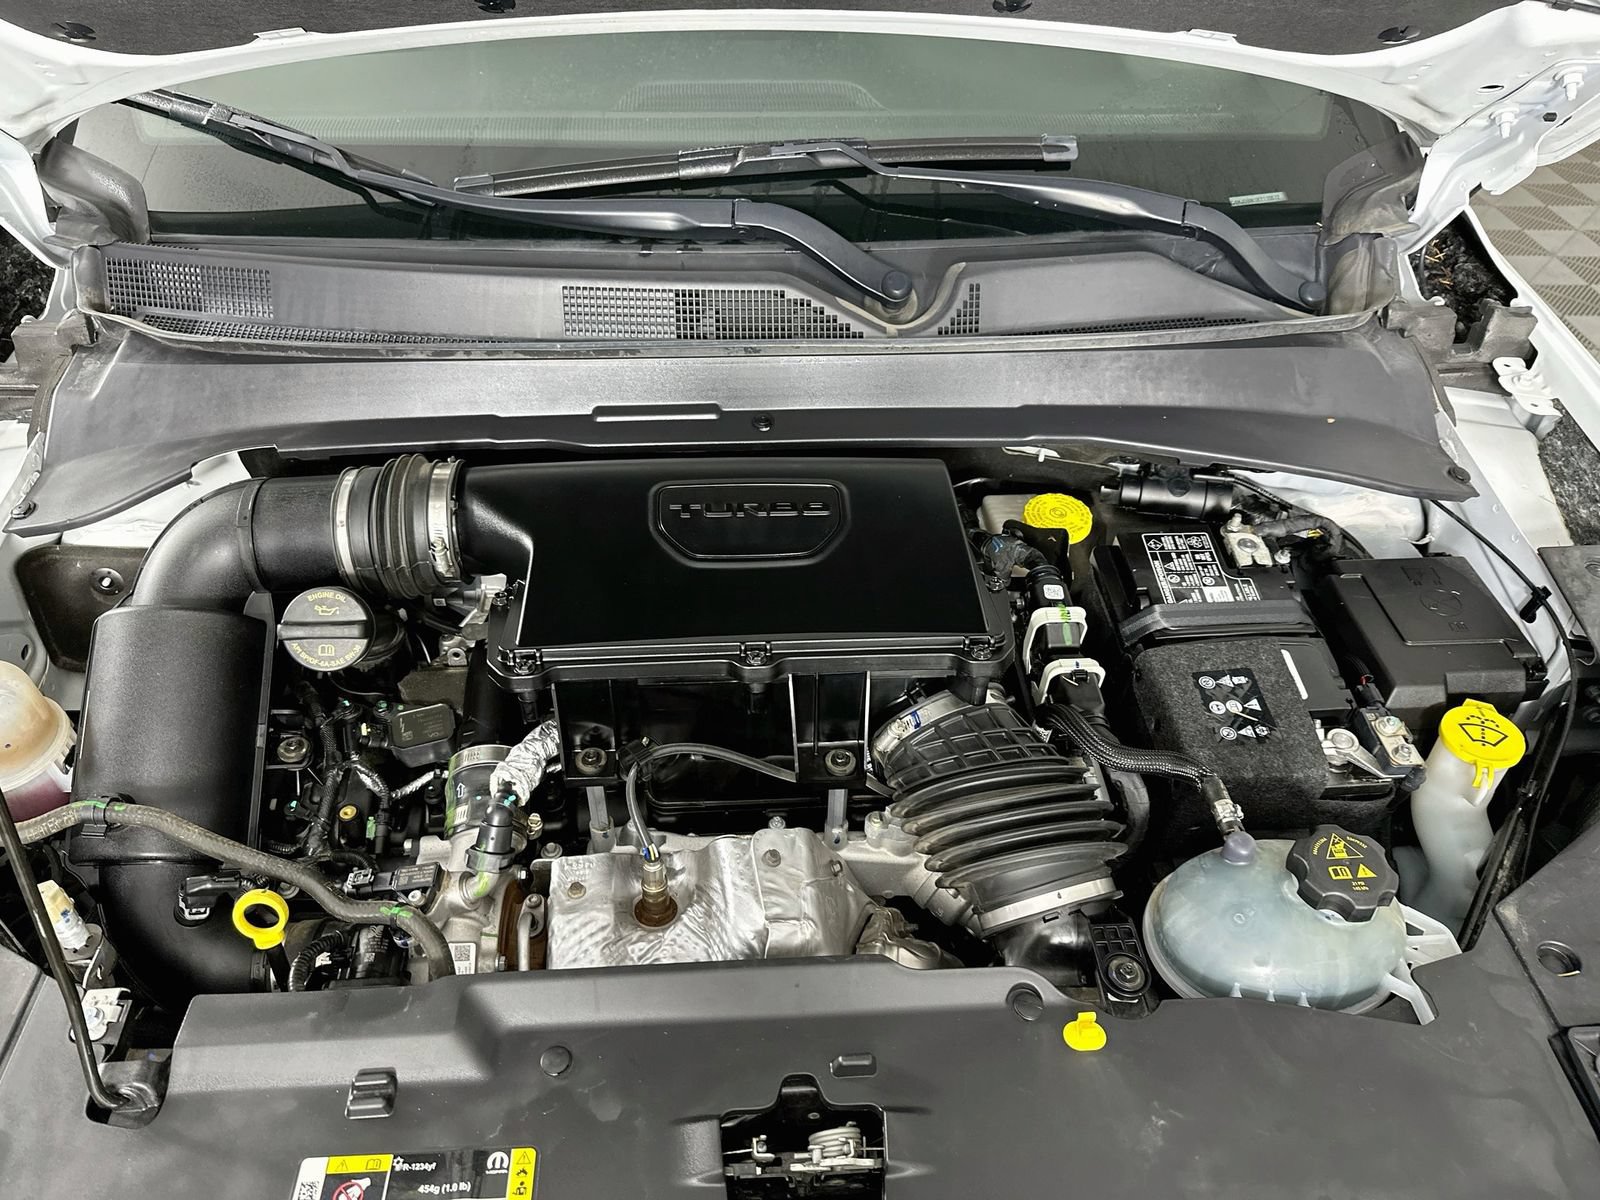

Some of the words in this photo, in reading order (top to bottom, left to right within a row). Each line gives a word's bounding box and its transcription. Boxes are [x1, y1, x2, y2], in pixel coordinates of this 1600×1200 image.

[307, 591, 335, 602] ENGINE
[335, 594, 347, 603] OIL
[291, 642, 302, 654] API
[402, 1162, 437, 1172] R-1234yf
[418, 1184, 440, 1195] 454g
[459, 1181, 472, 1192] lb)
